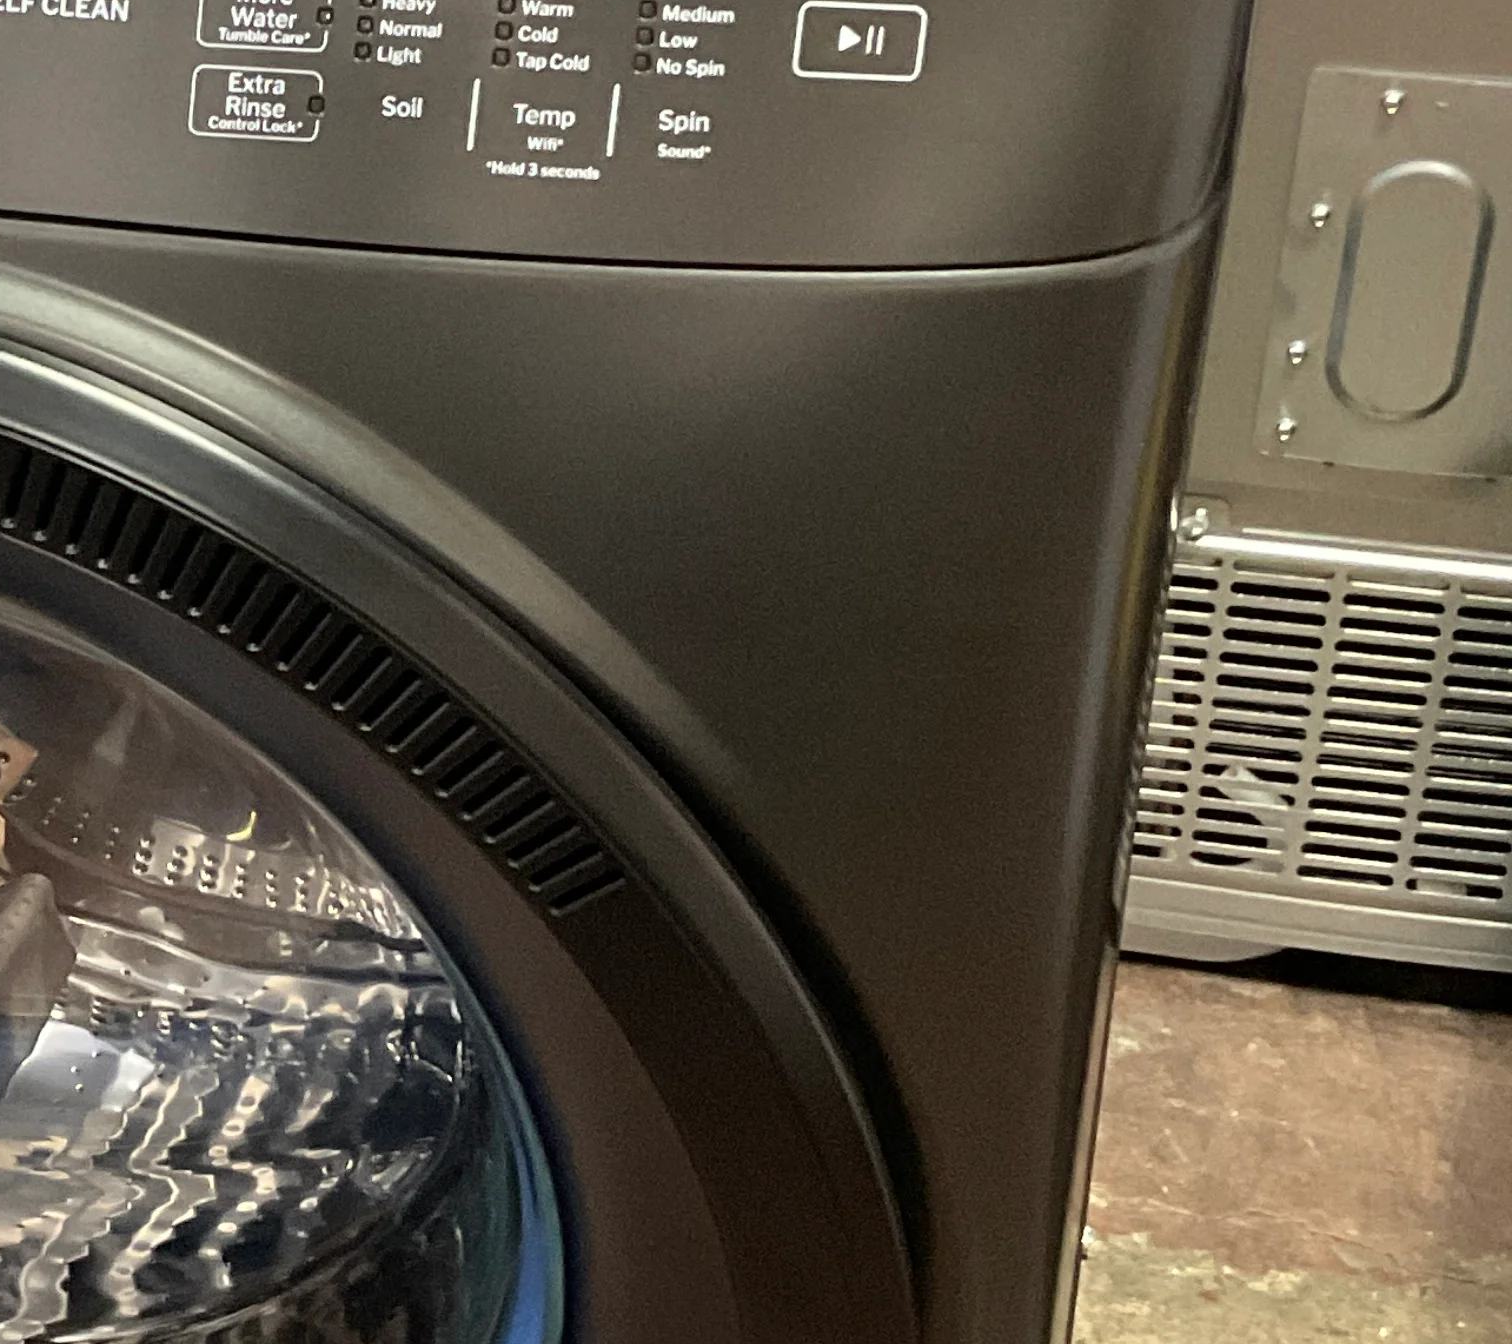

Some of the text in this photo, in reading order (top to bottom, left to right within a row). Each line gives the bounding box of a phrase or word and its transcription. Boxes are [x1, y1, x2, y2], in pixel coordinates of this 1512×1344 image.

[231, 6, 298, 30] Water
[522, 0, 574, 17] Warm
[662, 4, 735, 23] Medium
[218, 26, 269, 43] Tumble
[379, 19, 443, 39] Normal
[517, 25, 559, 43] Cold
[659, 30, 699, 49] Low
[376, 45, 423, 66] Light
[516, 51, 590, 72] Tap Cold
[656, 57, 726, 79] No Spin
[228, 71, 286, 95] Extra
[225, 95, 286, 119] Rinse
[381, 95, 424, 118] Soil
[513, 103, 576, 130] Temp
[207, 115, 260, 132] Control
[658, 109, 710, 135] Spin
[527, 161, 539, 177] 3
[540, 166, 601, 181] seconds
